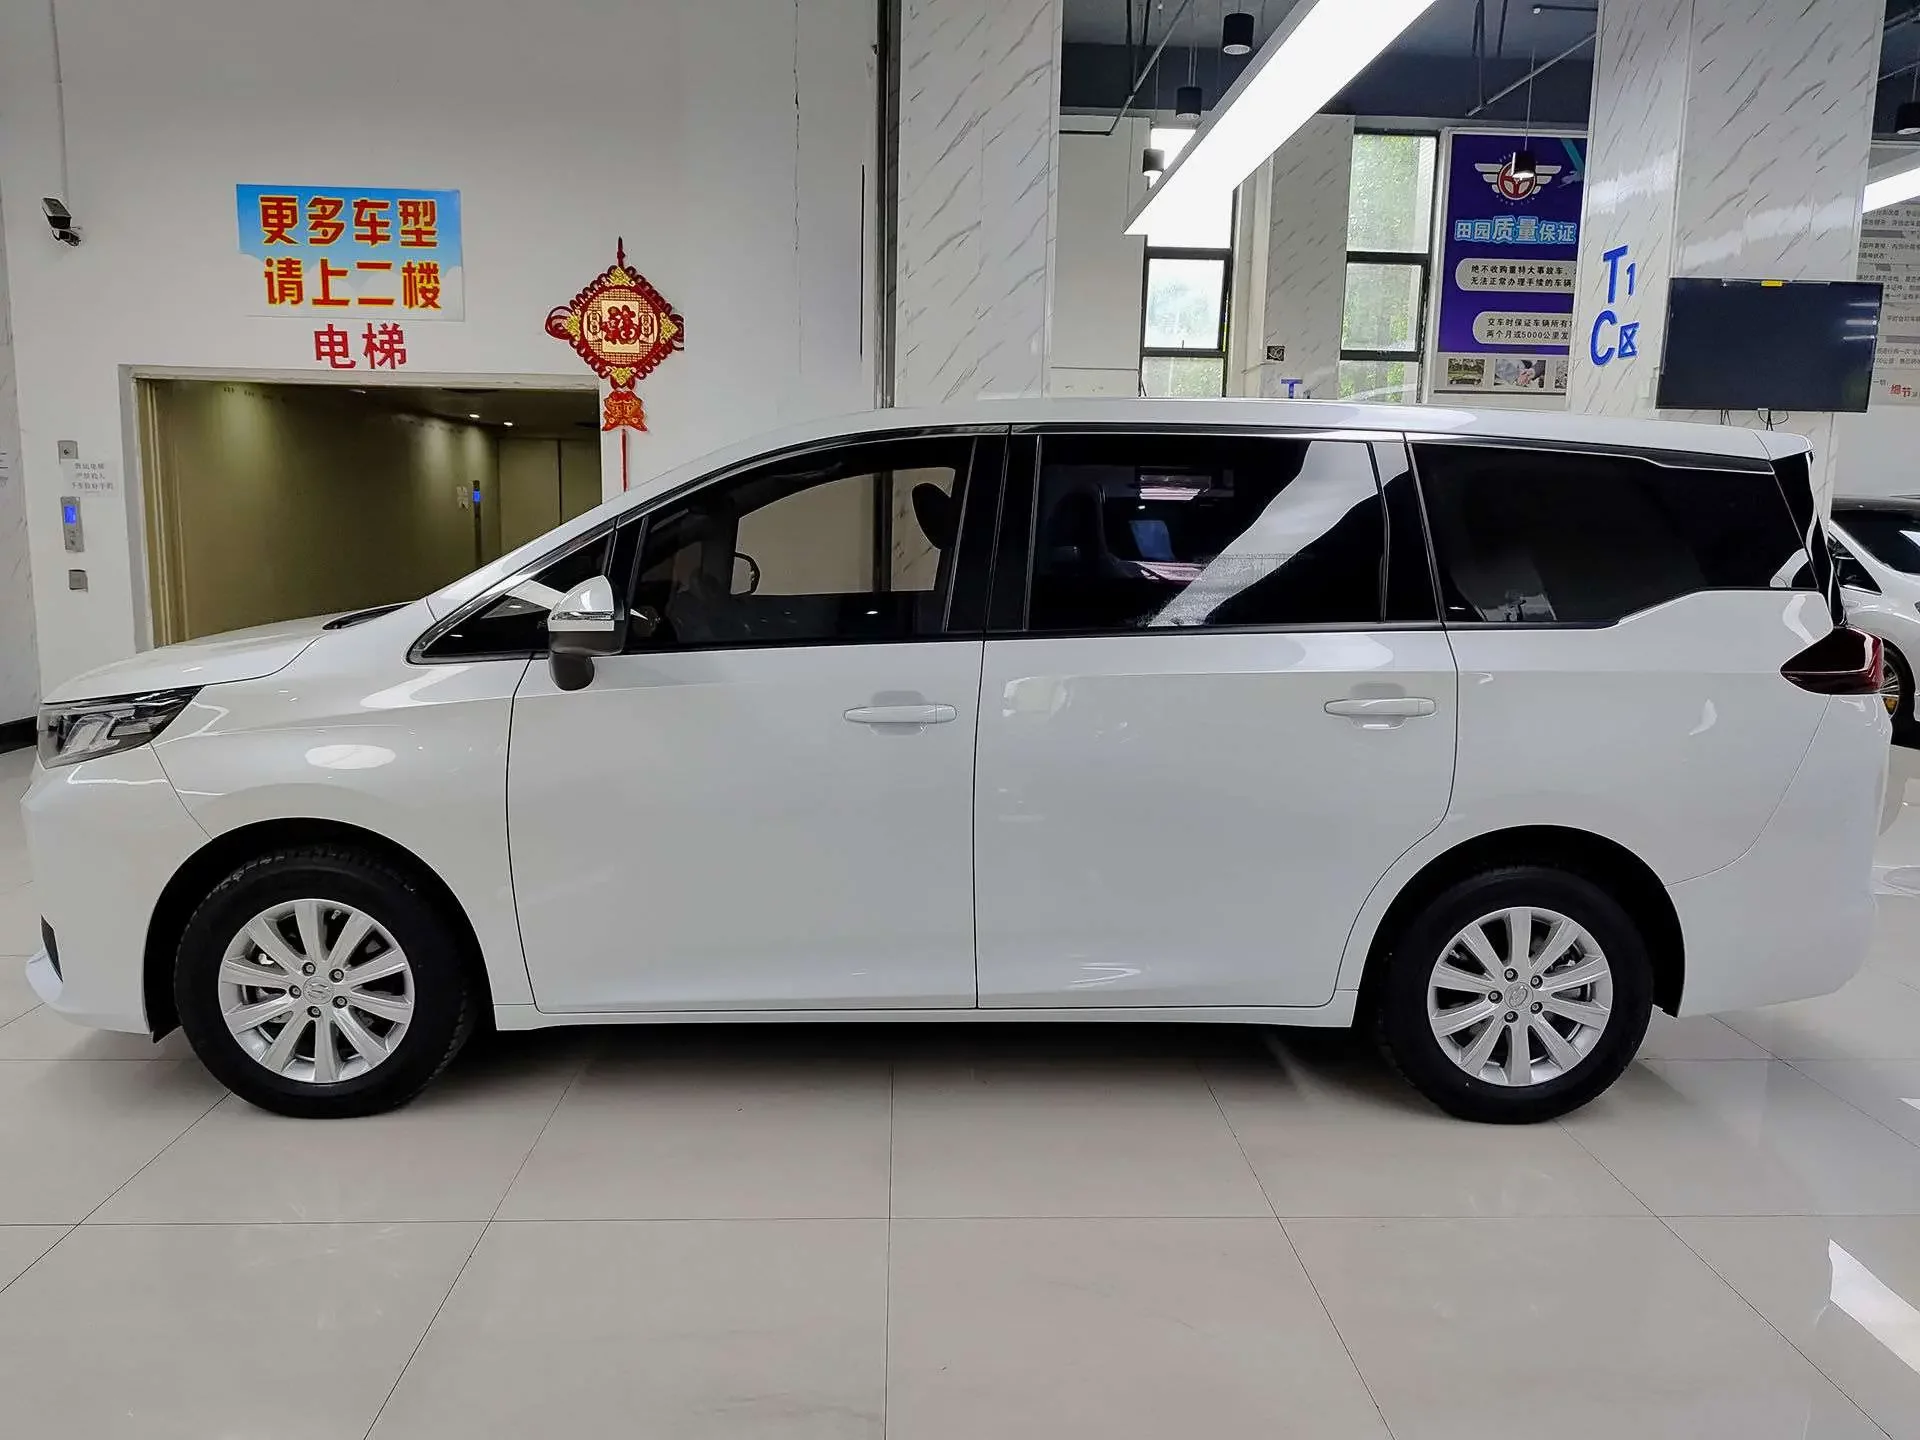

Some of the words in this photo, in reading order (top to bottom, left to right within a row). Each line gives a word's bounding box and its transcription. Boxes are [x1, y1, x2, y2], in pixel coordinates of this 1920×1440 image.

[259, 195, 438, 248] 更多车型
[1455, 216, 1577, 243] 田园质量保证
[264, 257, 441, 309] 请上二楼
[1603, 245, 1635, 303] T1
[313, 323, 407, 370] 电梯
[1590, 310, 1639, 366] C区
